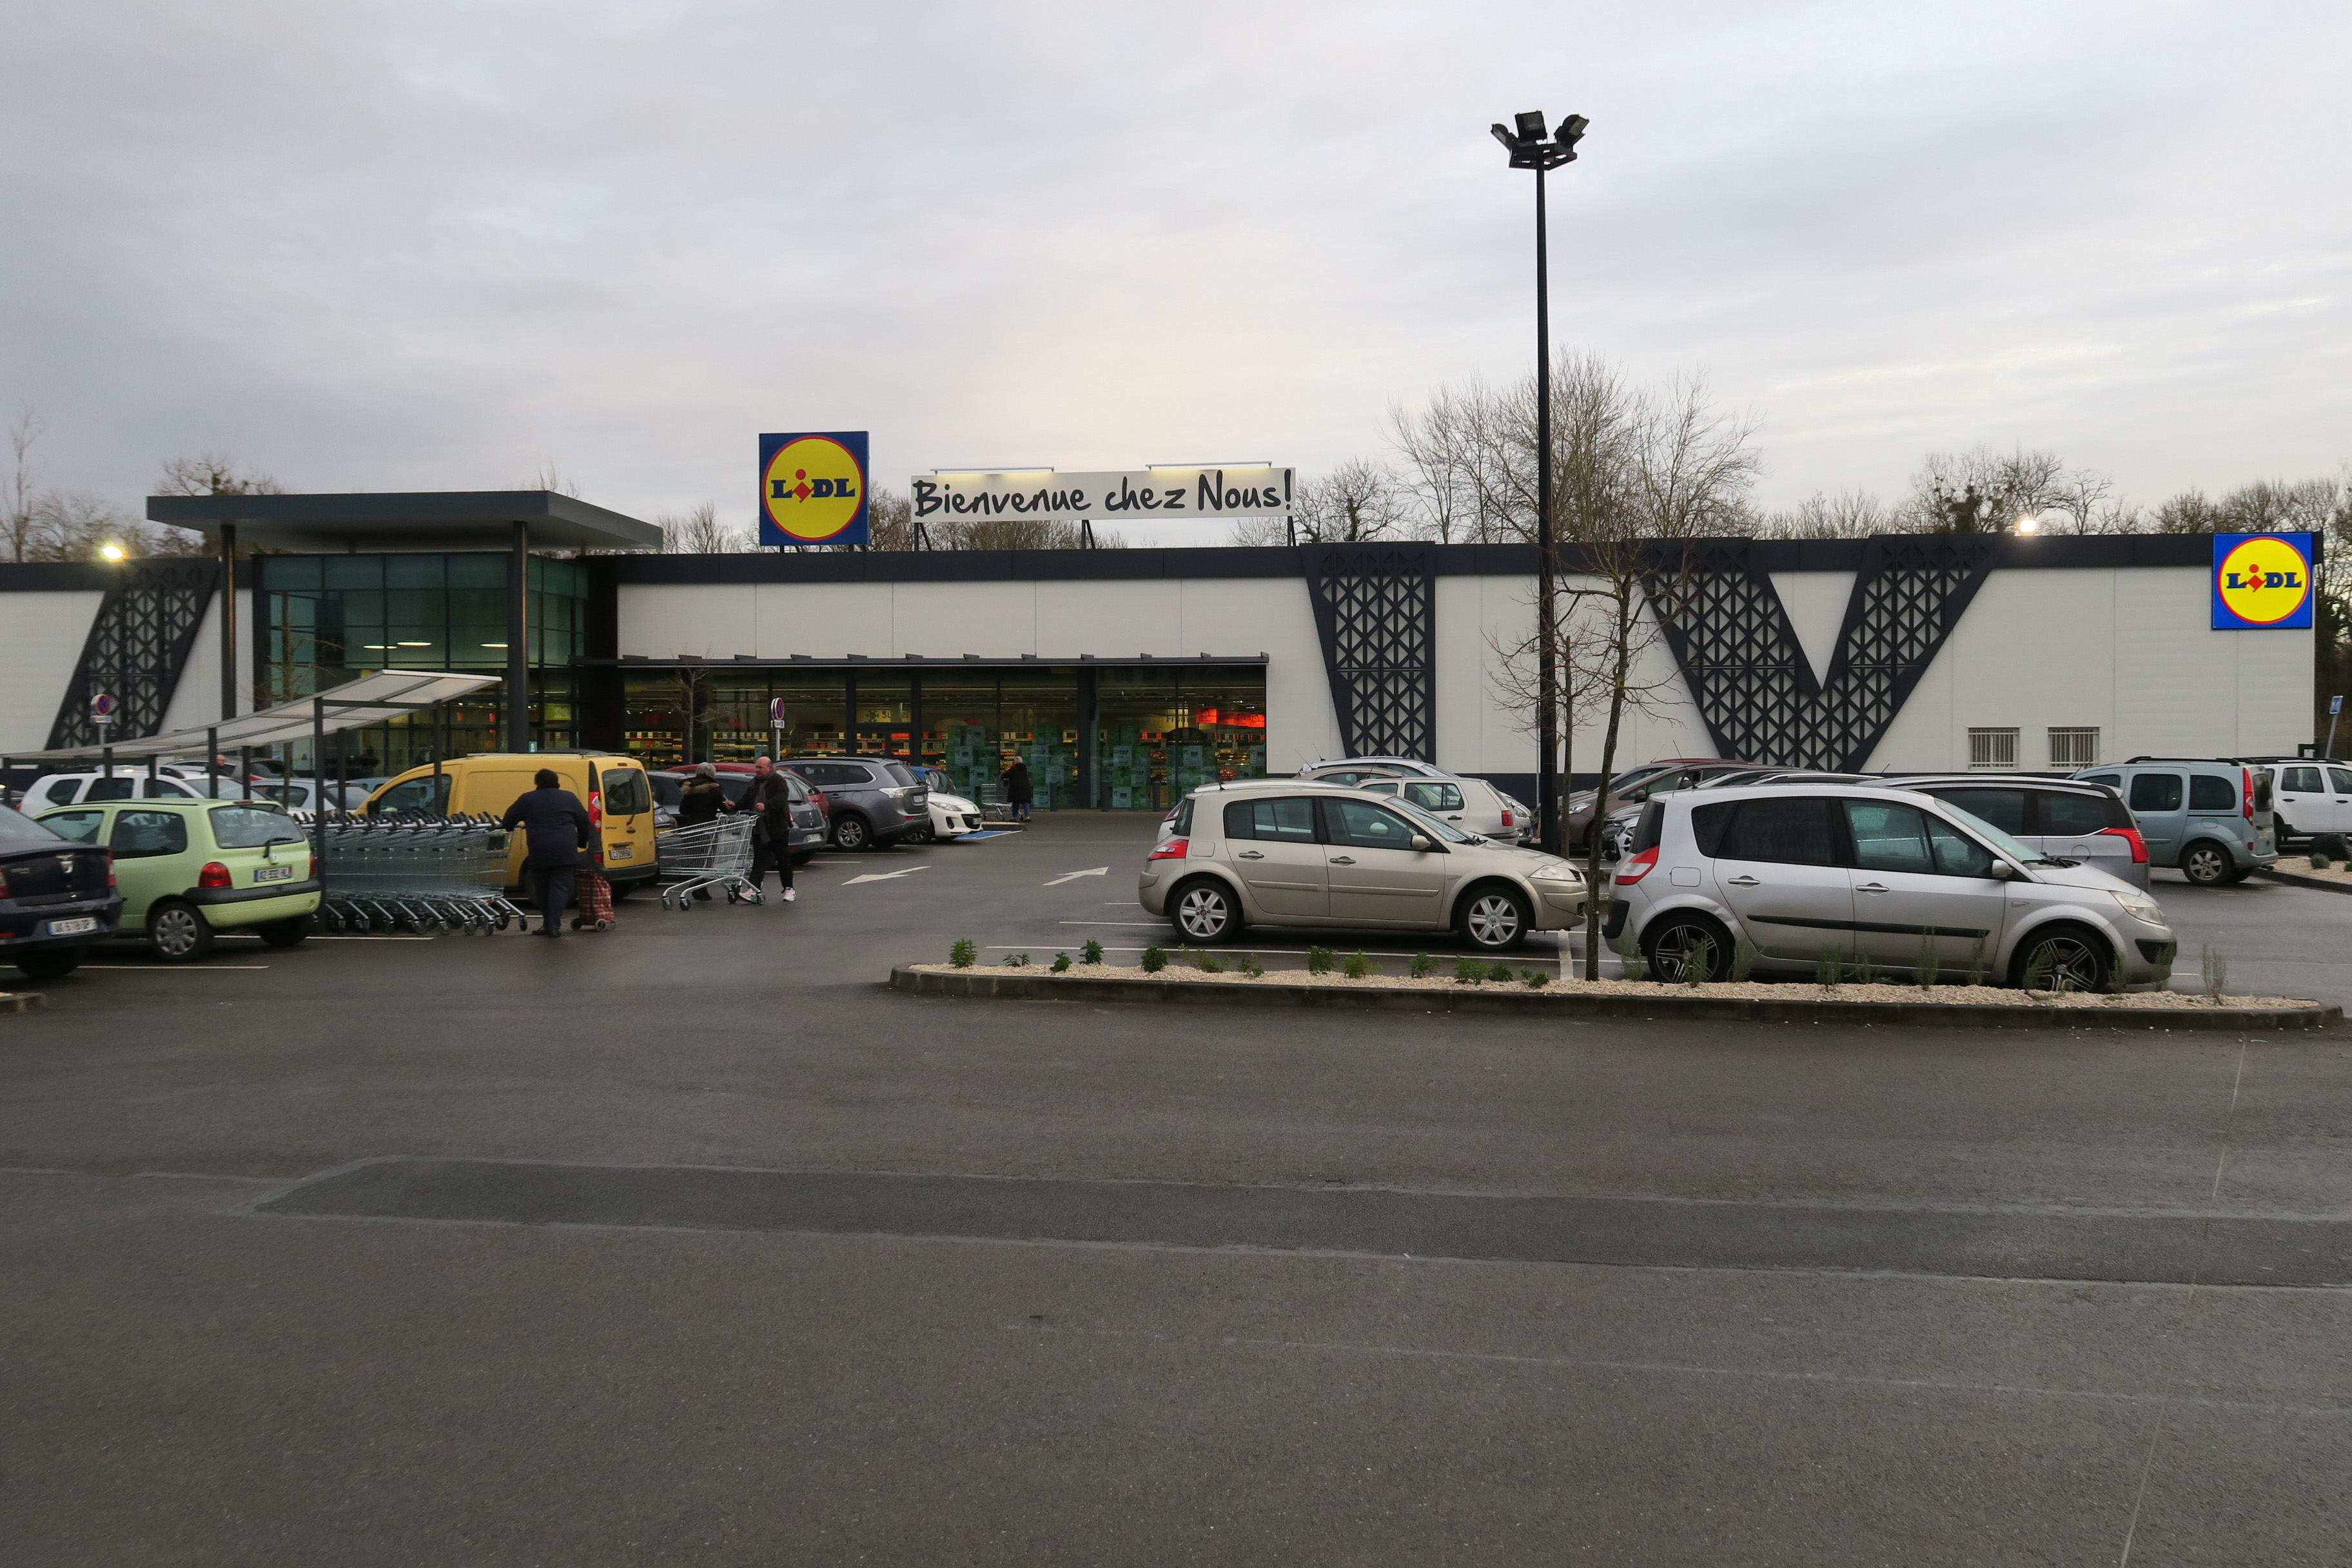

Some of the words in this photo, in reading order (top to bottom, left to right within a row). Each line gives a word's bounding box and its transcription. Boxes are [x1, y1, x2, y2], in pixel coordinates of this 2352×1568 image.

[913, 480, 1092, 517] Bienvenue
[1105, 476, 1186, 511] chez
[1198, 469, 1291, 511] Nous!
